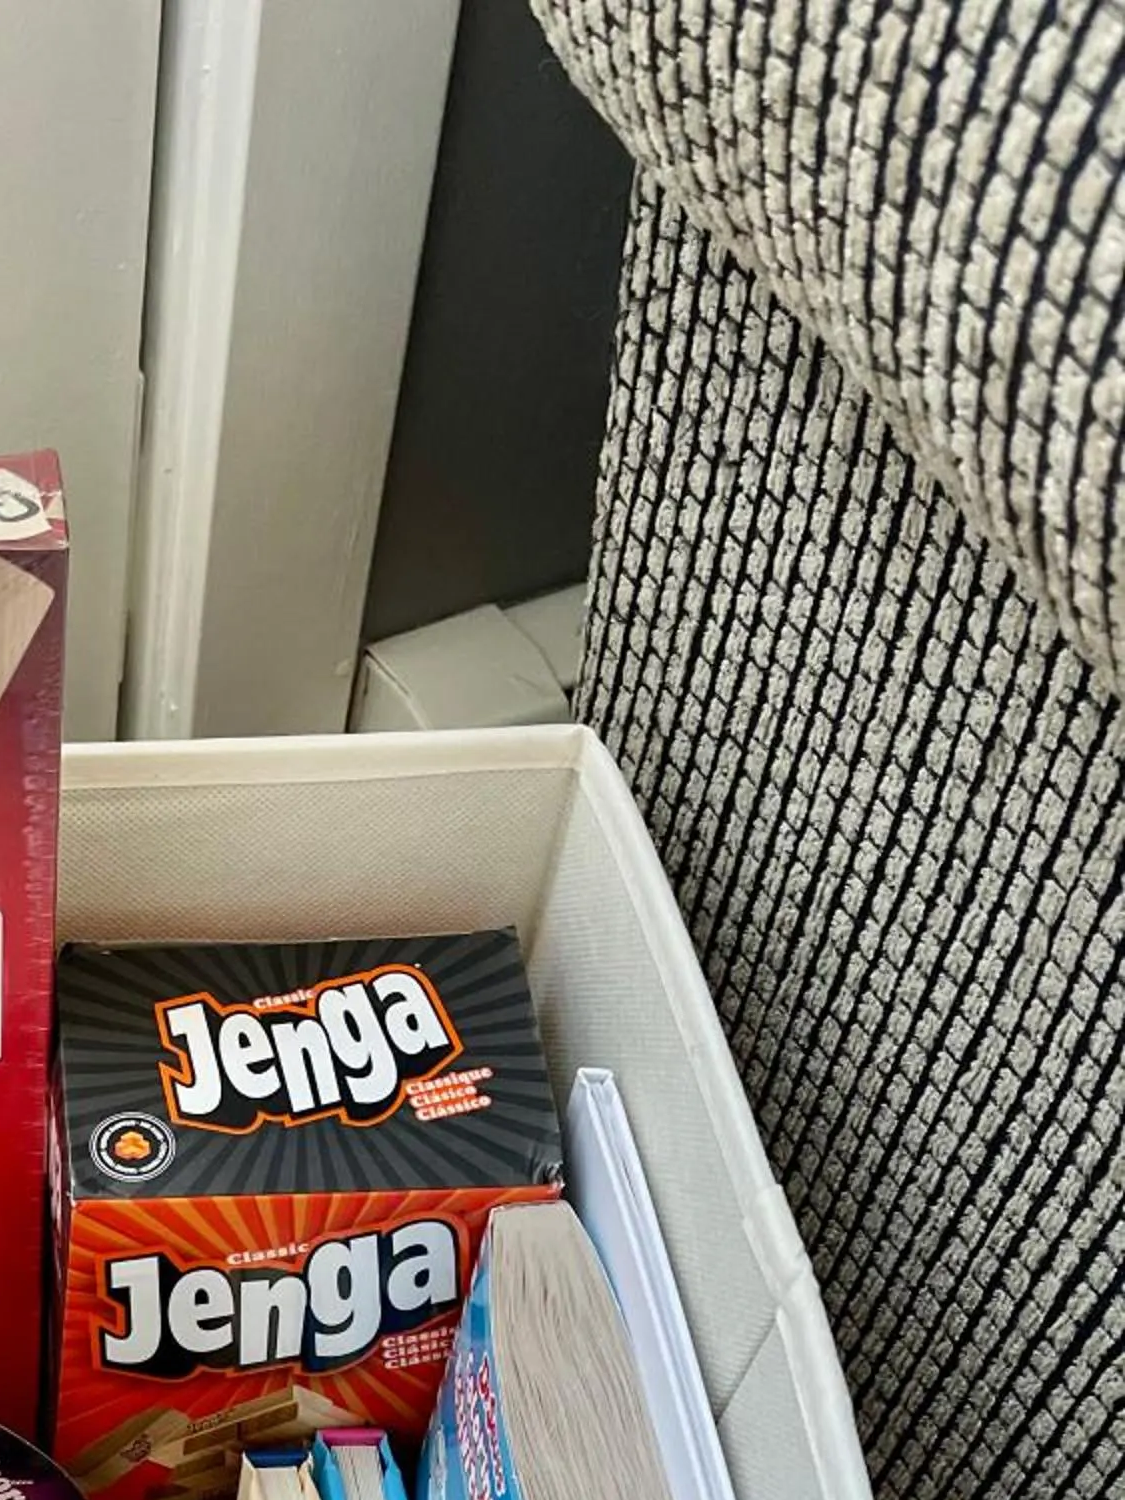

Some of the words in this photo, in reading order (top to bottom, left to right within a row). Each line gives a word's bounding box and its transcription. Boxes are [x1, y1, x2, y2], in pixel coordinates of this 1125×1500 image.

[253, 988, 315, 1009] Classic
[166, 971, 450, 1117] Jenga
[405, 1066, 493, 1095] Classique
[410, 1085, 477, 1108] Clásico
[415, 1096, 493, 1121] Clássico
[227, 1240, 310, 1267] Classic
[105, 1221, 458, 1366] Jenga
[382, 1326, 455, 1349] Classi
[382, 1340, 451, 1360] Clásic
[384, 1349, 449, 1370] Clássi
